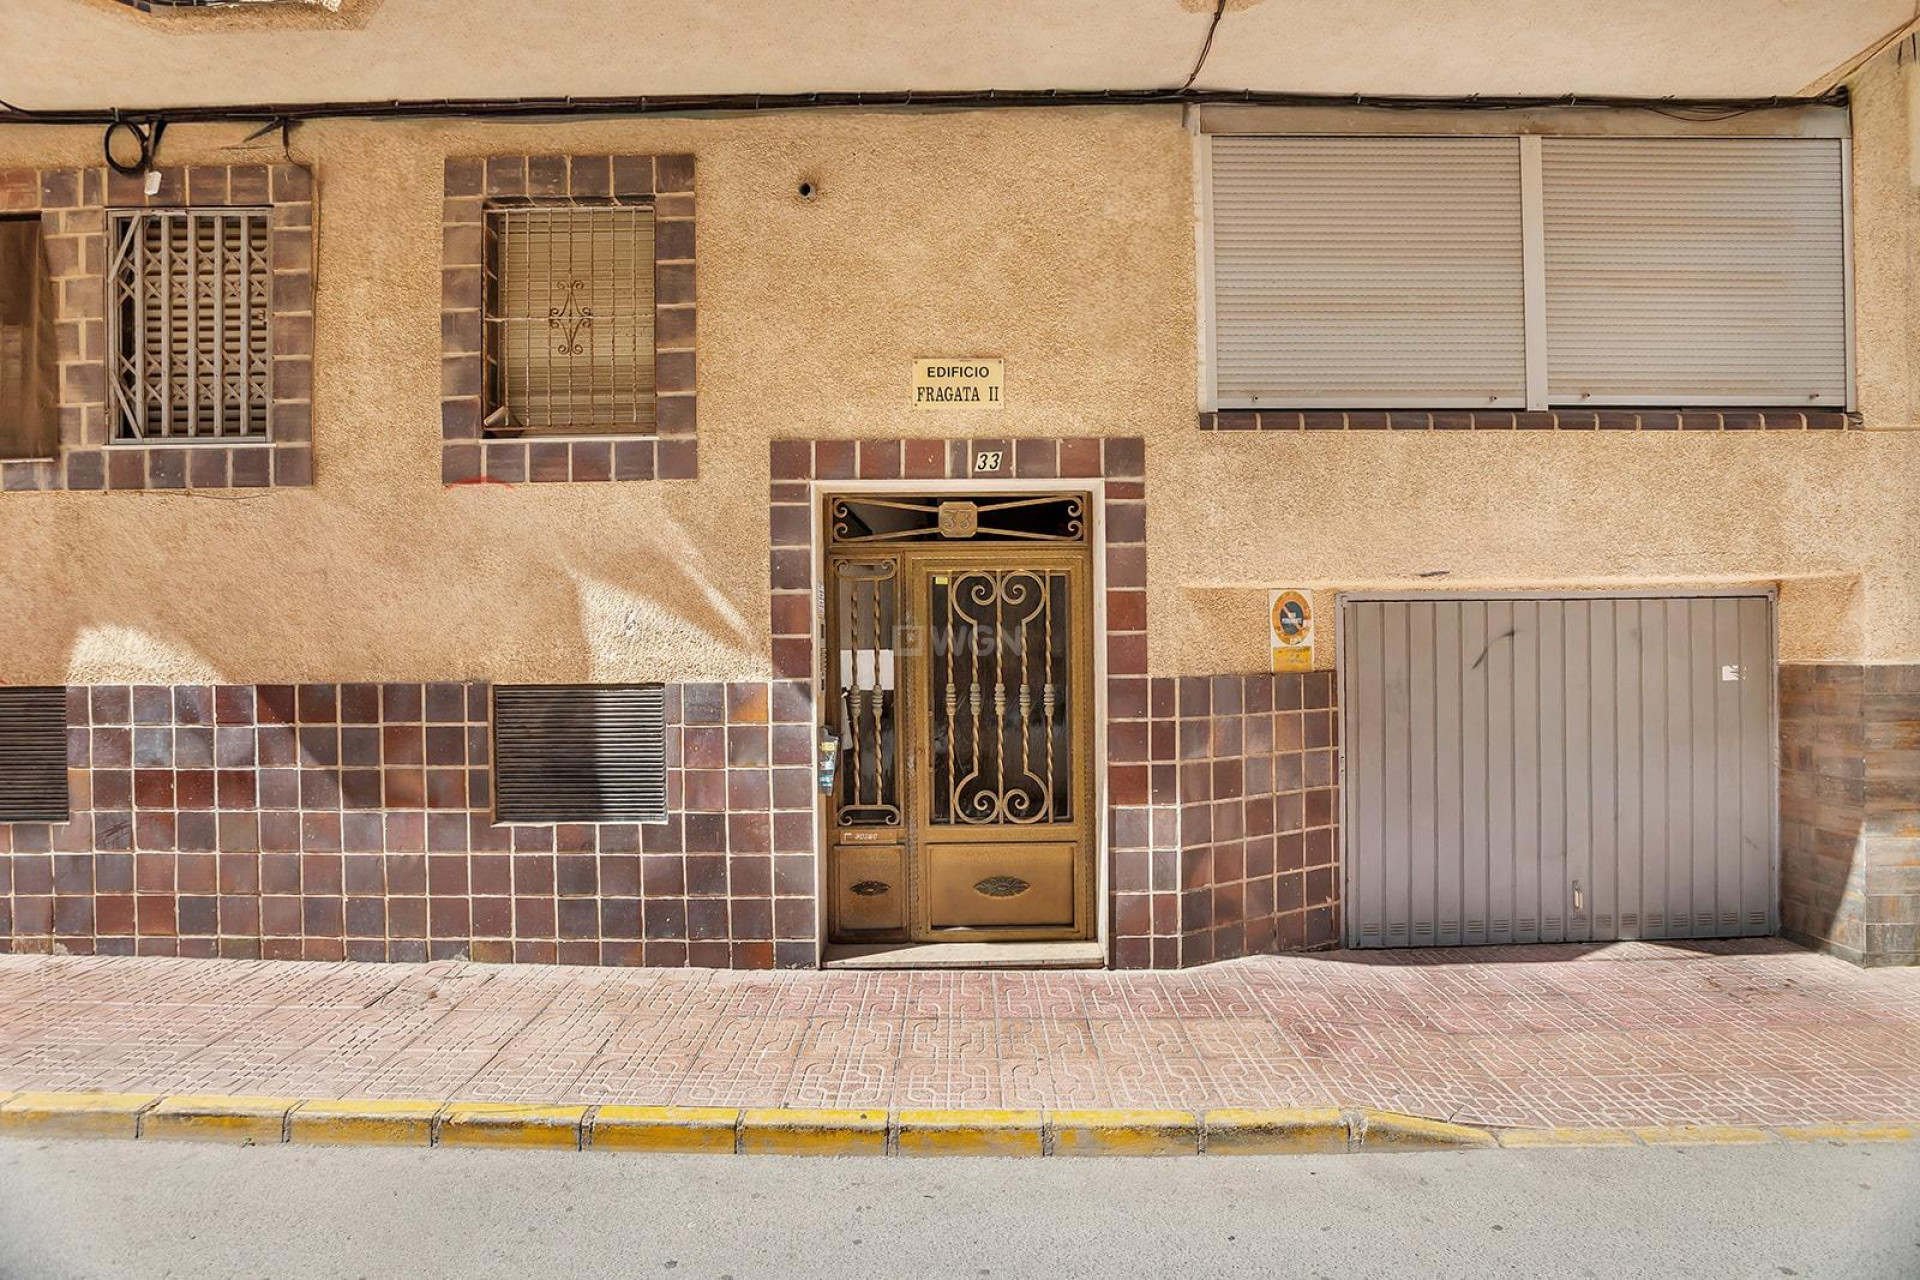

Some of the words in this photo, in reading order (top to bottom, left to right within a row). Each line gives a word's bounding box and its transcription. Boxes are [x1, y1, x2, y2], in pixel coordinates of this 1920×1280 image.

[927, 366, 990, 378] EDIFICIO
[917, 386, 980, 402] FRAGATA
[988, 386, 999, 402] II
[977, 453, 1000, 470] 33
